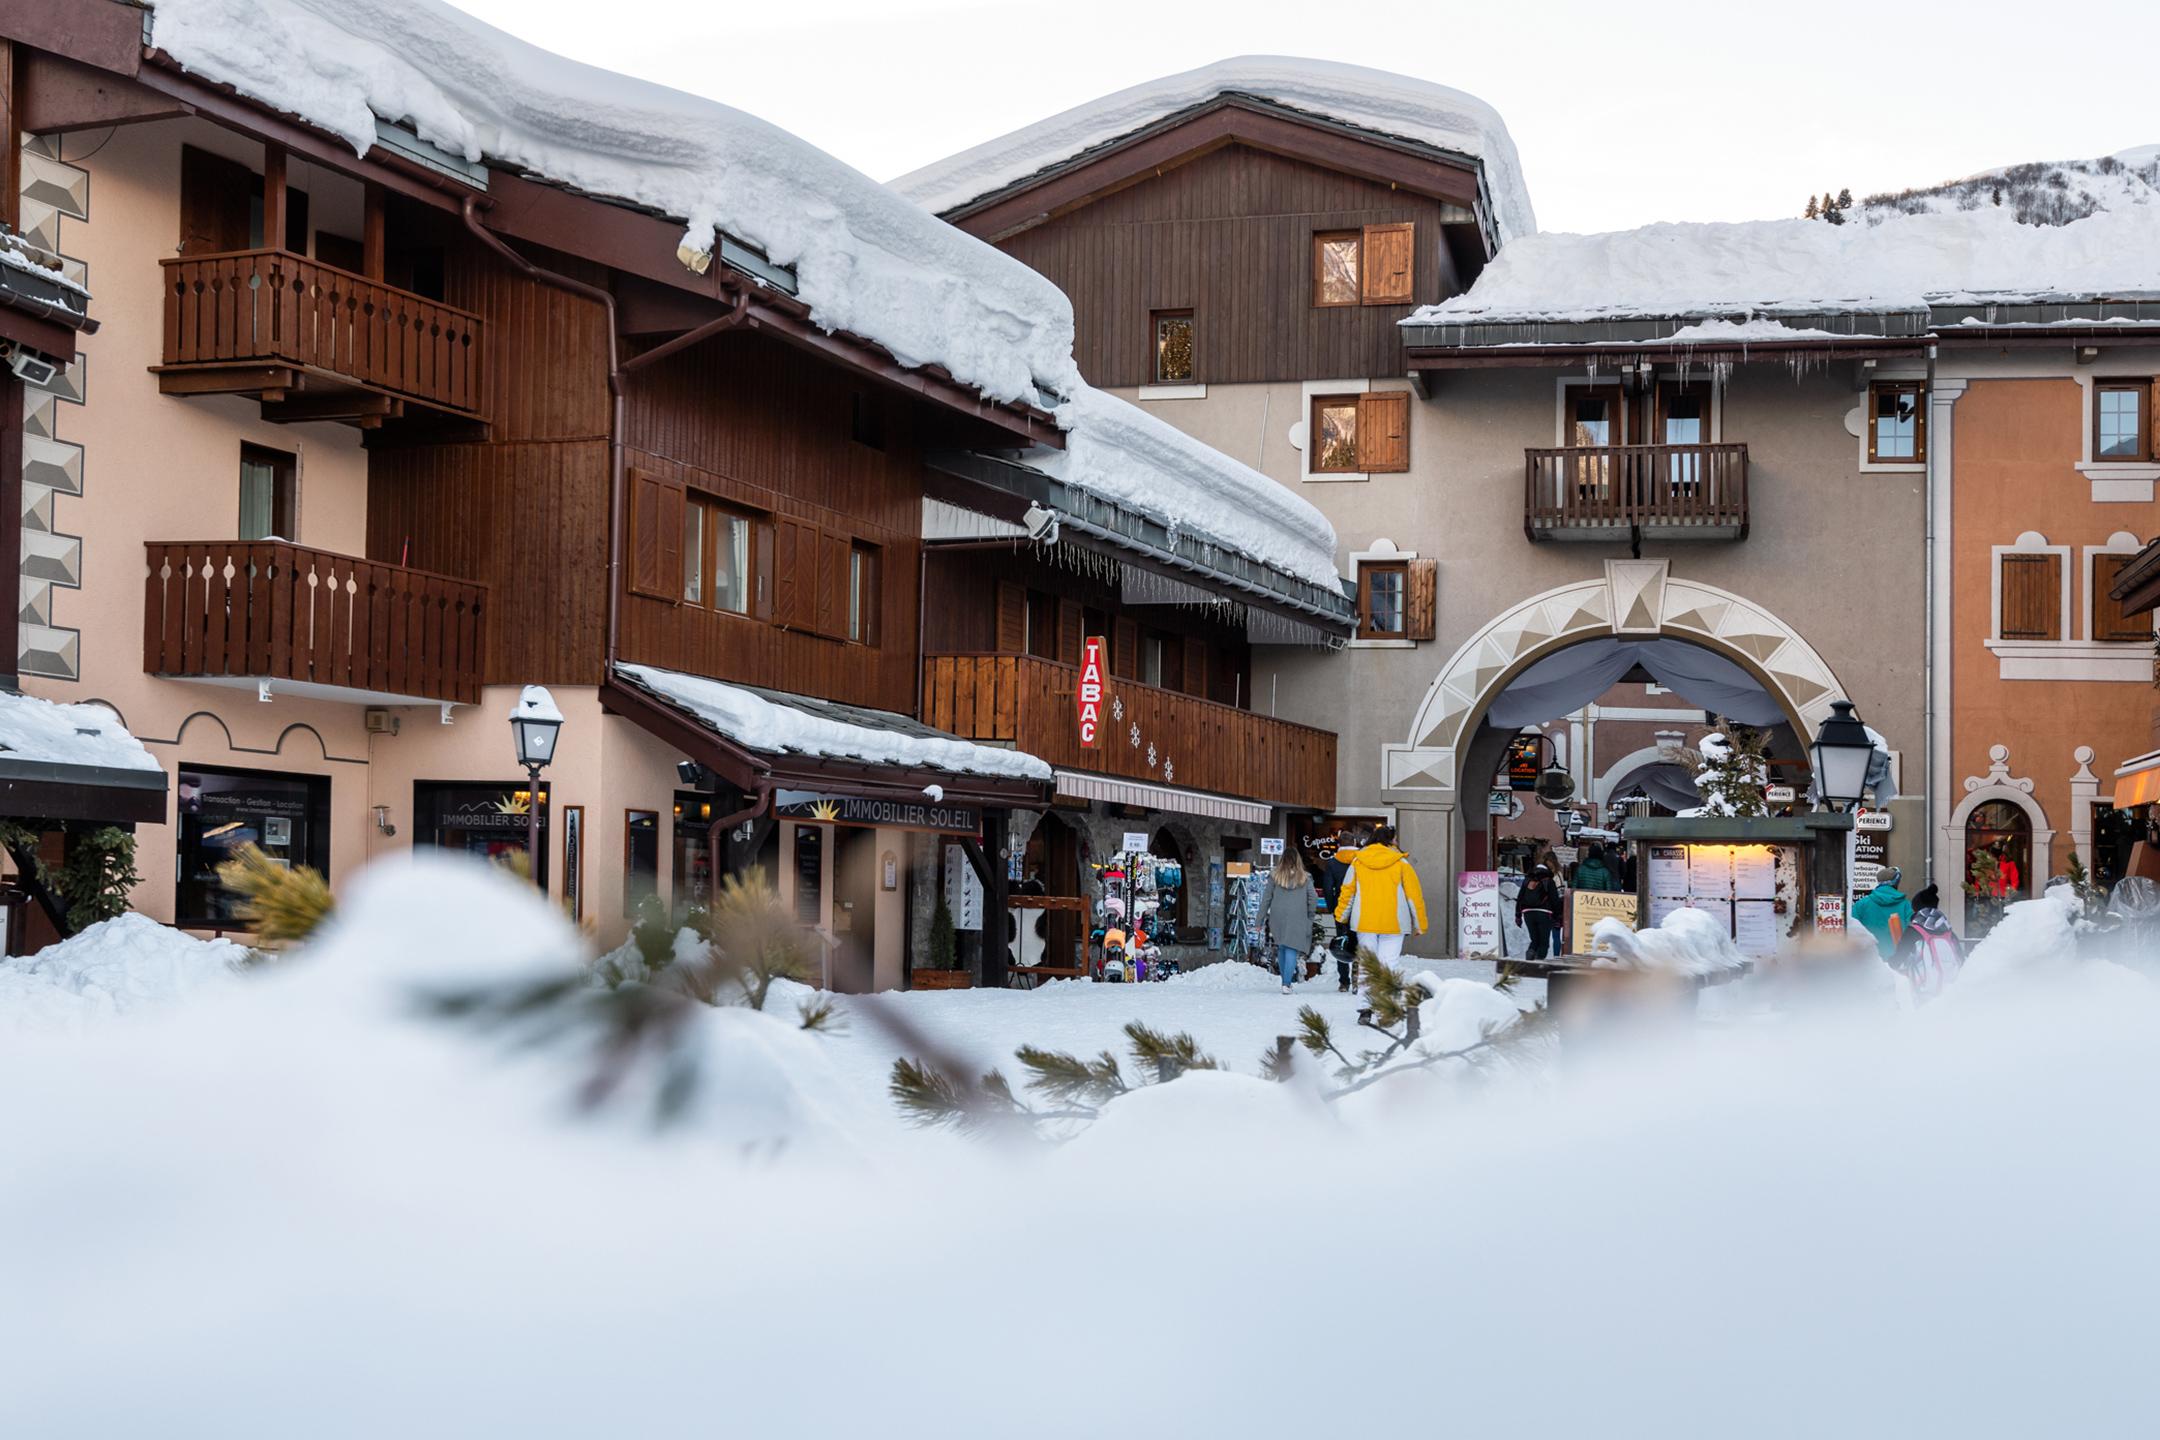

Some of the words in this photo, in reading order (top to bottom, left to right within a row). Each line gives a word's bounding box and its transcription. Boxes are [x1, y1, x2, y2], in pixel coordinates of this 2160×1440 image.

[1081, 644, 1101, 742] TABAC
[203, 793, 241, 804] Transaction
[246, 797, 272, 806] Gestion
[275, 800, 305, 809] Location
[442, 814, 510, 826] IMMOBILIER
[843, 799, 926, 826] IMMOBILIER
[929, 807, 974, 829] SOLEIL
[1471, 874, 1493, 883] SPA
[1465, 897, 1491, 910] Espace
[1820, 902, 1840, 910] 2018
[1460, 907, 1480, 918] Bien
